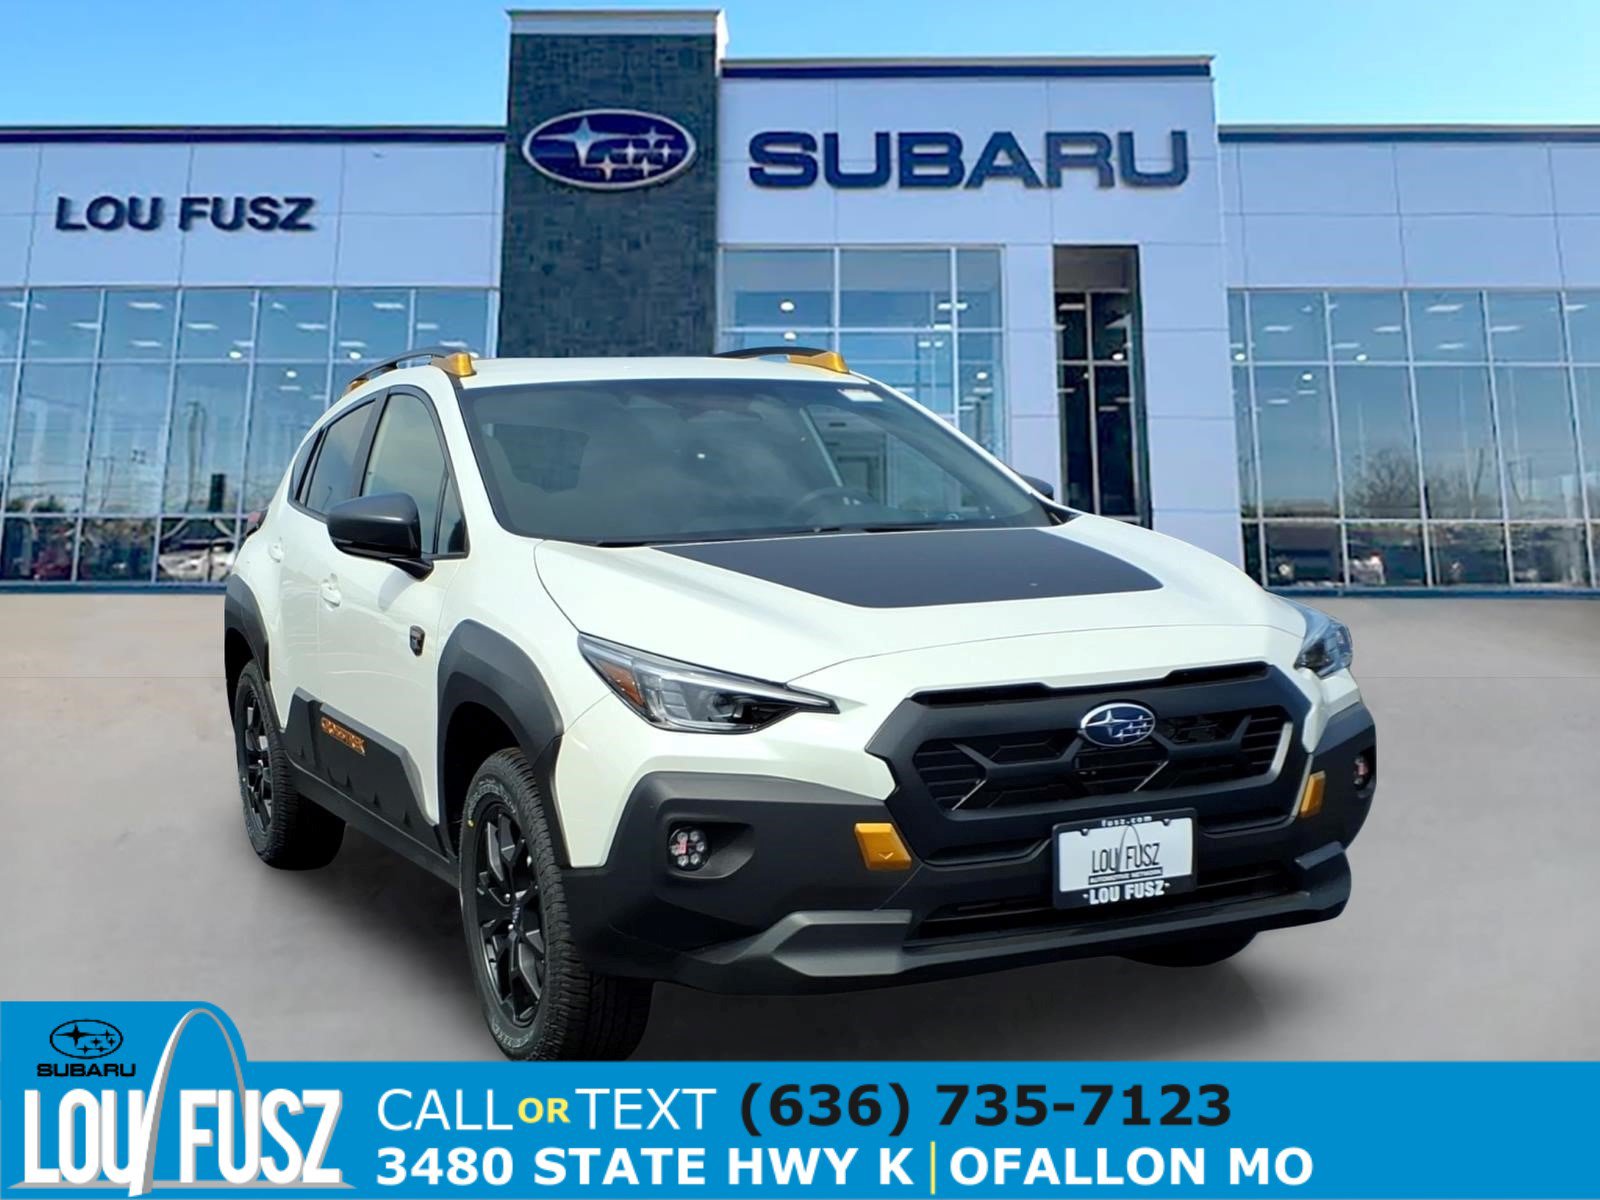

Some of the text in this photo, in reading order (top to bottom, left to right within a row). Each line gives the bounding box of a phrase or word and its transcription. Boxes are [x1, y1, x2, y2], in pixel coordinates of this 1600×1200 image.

[748, 130, 1190, 188] SUBARU
[55, 195, 316, 231] LOU FUSZ
[1091, 843, 1161, 874] LOU FUSZ
[1089, 879, 1165, 905] LOU FUSZ
